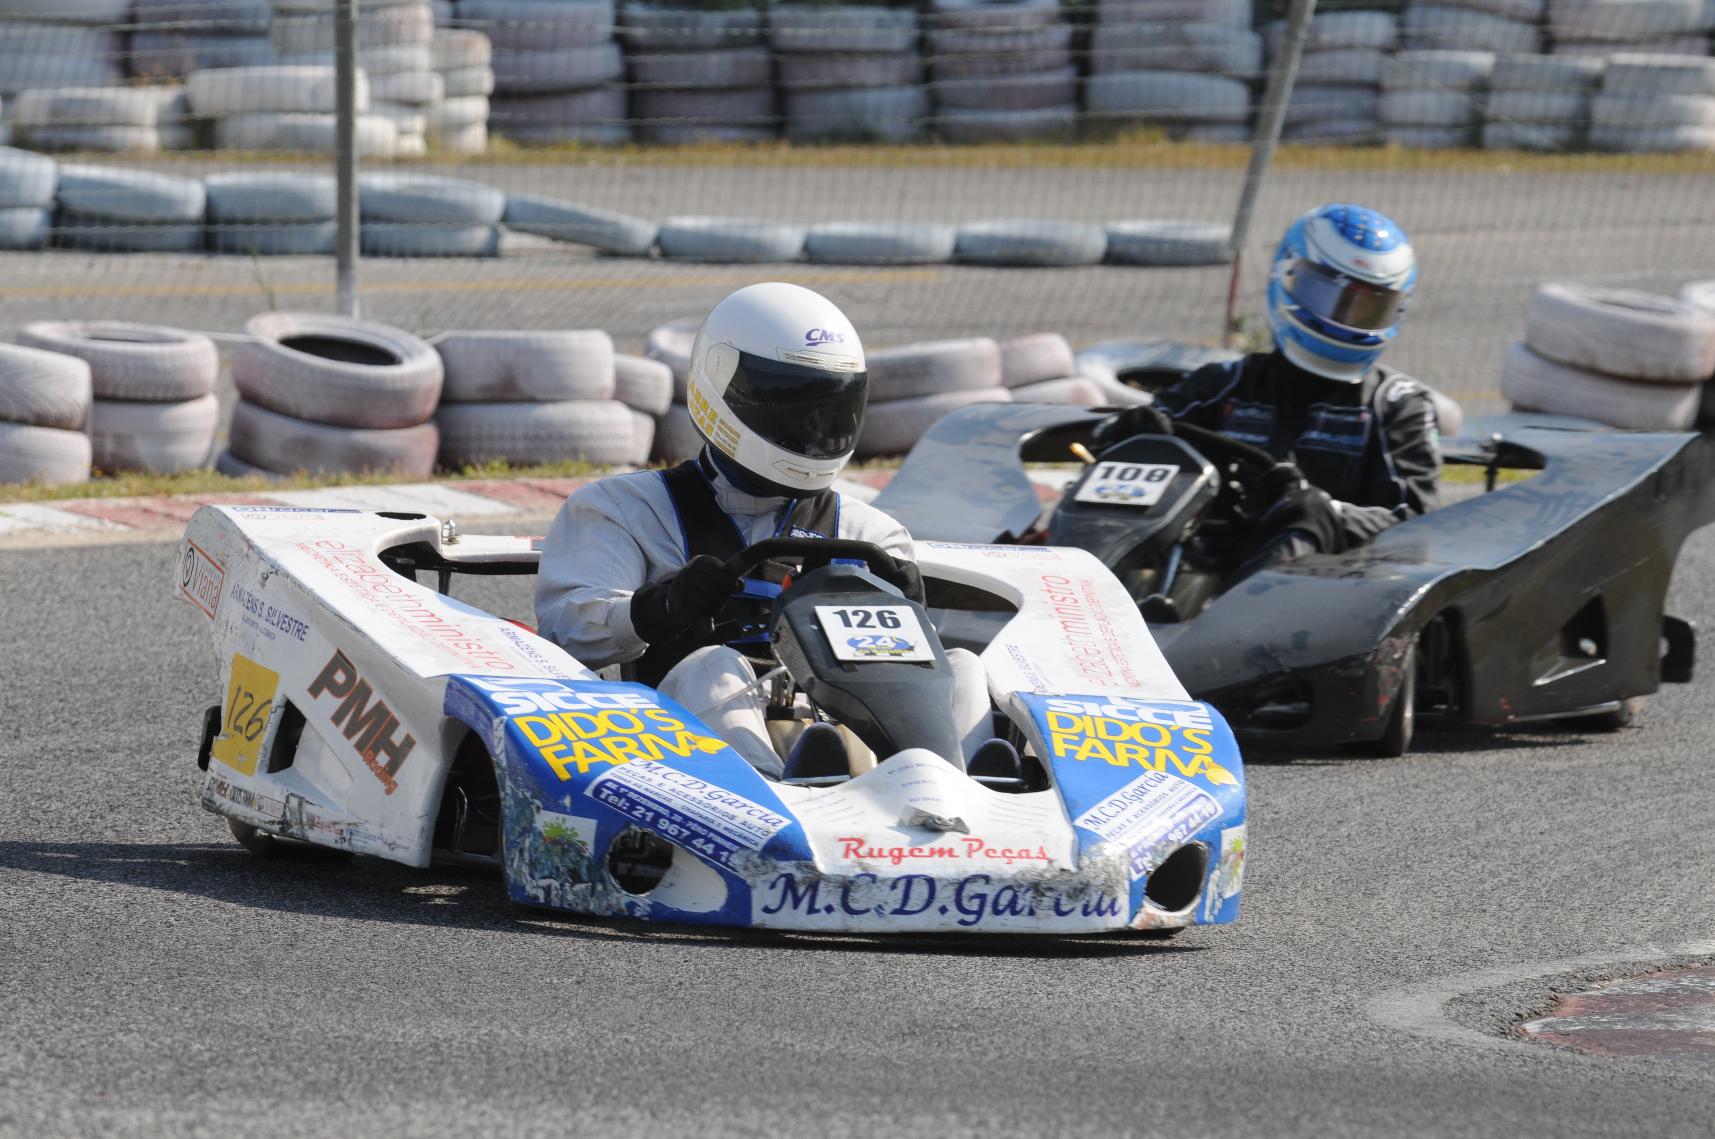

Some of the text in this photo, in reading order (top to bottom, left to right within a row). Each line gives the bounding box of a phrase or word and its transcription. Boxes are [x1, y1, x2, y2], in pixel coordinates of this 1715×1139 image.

[805, 328, 844, 344] CMS
[265, 605, 310, 642] SILVESTRE
[833, 609, 901, 628] 126
[227, 684, 272, 741] 126
[307, 648, 417, 779] PMH
[490, 691, 661, 715] SICCE
[1045, 699, 1214, 731] SICCE
[513, 707, 686, 748] DIDO'S
[1045, 710, 1213, 755] DIDO'S
[600, 787, 630, 811] Tel:
[631, 805, 655, 822] 21
[657, 817, 691, 839] 967
[692, 837, 715, 855] 44
[837, 837, 960, 865] Rugem
